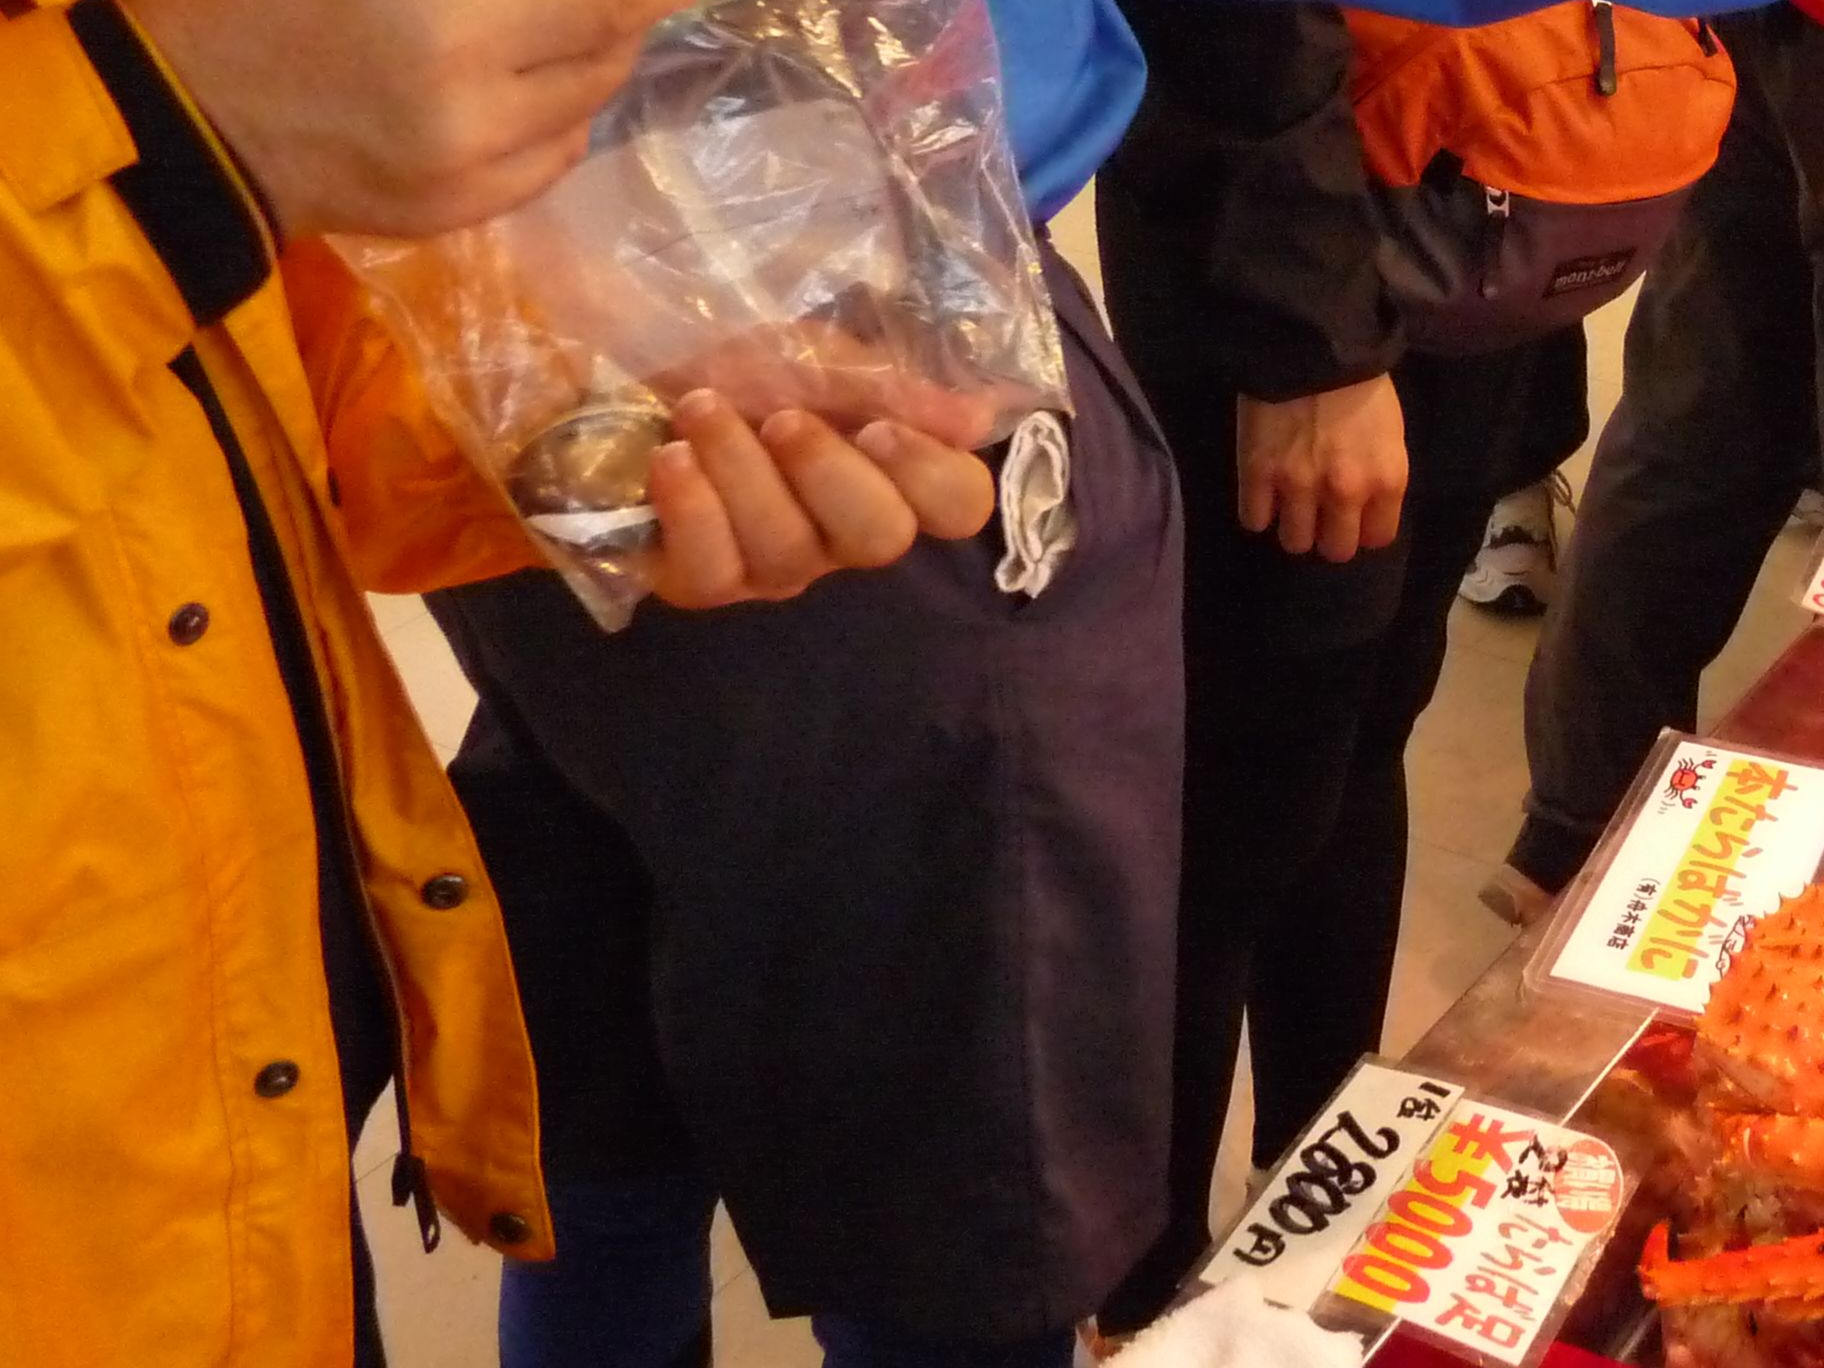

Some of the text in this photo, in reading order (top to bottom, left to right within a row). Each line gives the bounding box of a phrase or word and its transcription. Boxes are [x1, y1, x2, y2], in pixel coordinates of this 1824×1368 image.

[1640, 761, 1799, 980] 本たらばがに
[1343, 1113, 1537, 1304] ¥5000
